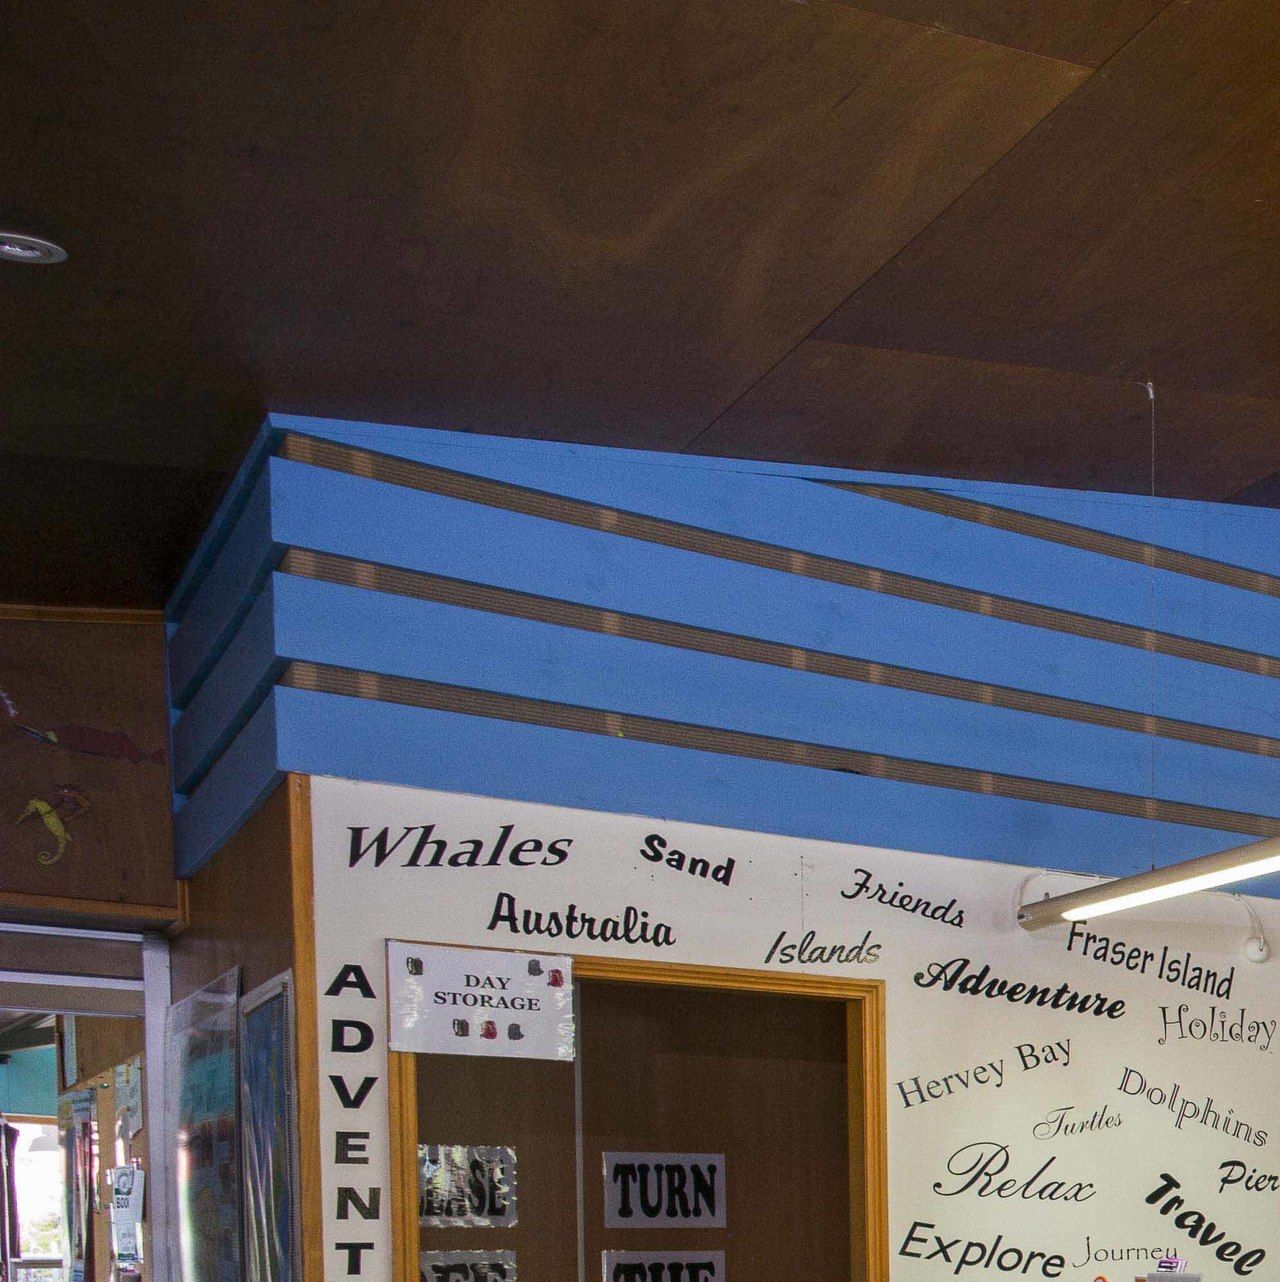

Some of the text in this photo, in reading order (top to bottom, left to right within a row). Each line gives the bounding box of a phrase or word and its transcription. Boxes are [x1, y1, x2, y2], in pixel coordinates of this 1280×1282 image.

[345, 824, 574, 869] Whales
[639, 833, 736, 887] Sand
[486, 892, 677, 947] Australia
[838, 868, 966, 929] Friends
[763, 930, 884, 966] Islands
[1067, 920, 1235, 1000] Fraser Island
[433, 990, 542, 1013] STORAGE
[464, 974, 511, 991] DAY
[913, 957, 1126, 1020] Adventure
[1158, 1003, 1277, 1054] Holiday
[894, 1038, 1073, 1110] Hervey Bay
[1032, 1104, 1126, 1141] Turtles
[1117, 1066, 1269, 1148] Dolphins
[612, 1163, 718, 1219] TURN
[932, 1141, 1097, 1202] Relax
[1218, 1159, 1280, 1195] Pier
[898, 1220, 1066, 1279] Explore
[1144, 1172, 1268, 1276] Travel
